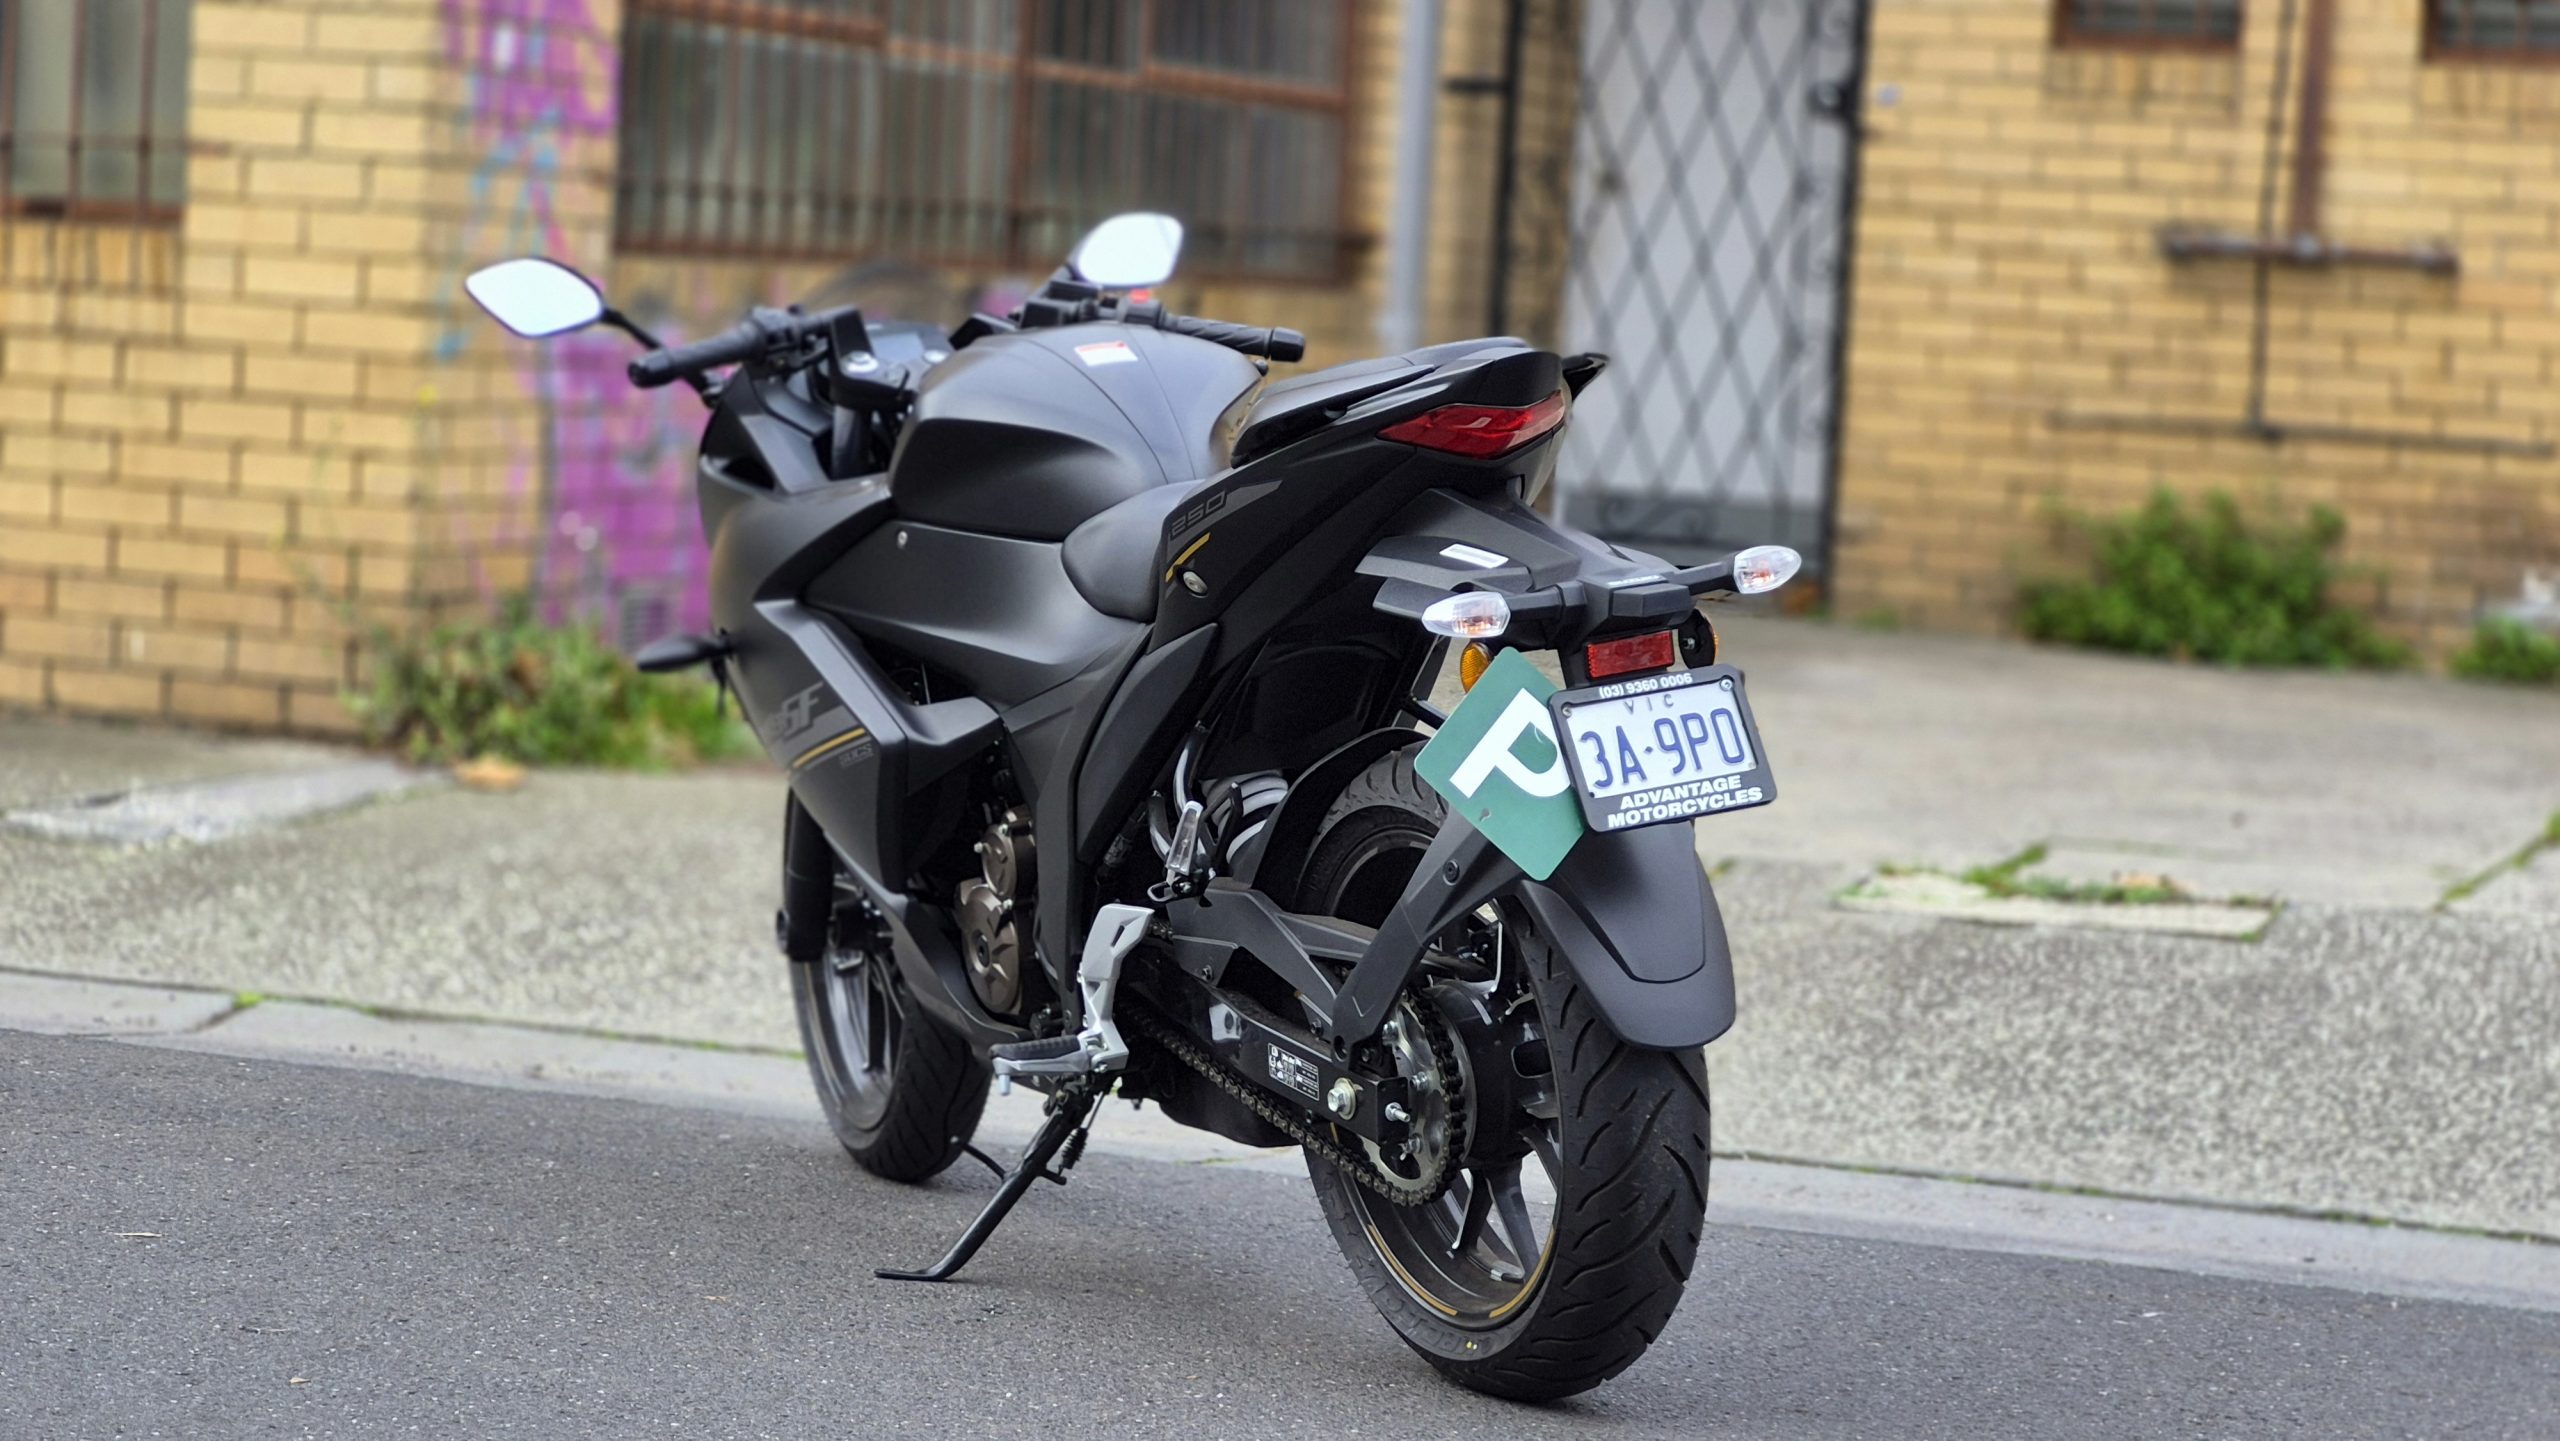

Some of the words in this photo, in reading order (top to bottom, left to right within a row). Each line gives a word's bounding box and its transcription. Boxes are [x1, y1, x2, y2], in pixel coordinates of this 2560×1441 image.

[1171, 490, 1226, 537] 250
[1598, 683, 1624, 699] (03)
[1626, 679, 1659, 695] 9360
[1659, 672, 1694, 689] 0006
[1623, 694, 1675, 714] VIC
[1449, 687, 1572, 799] P
[1607, 786, 1764, 829] MOTORCYCLES
[1620, 775, 1742, 810] ADVANTAGE
